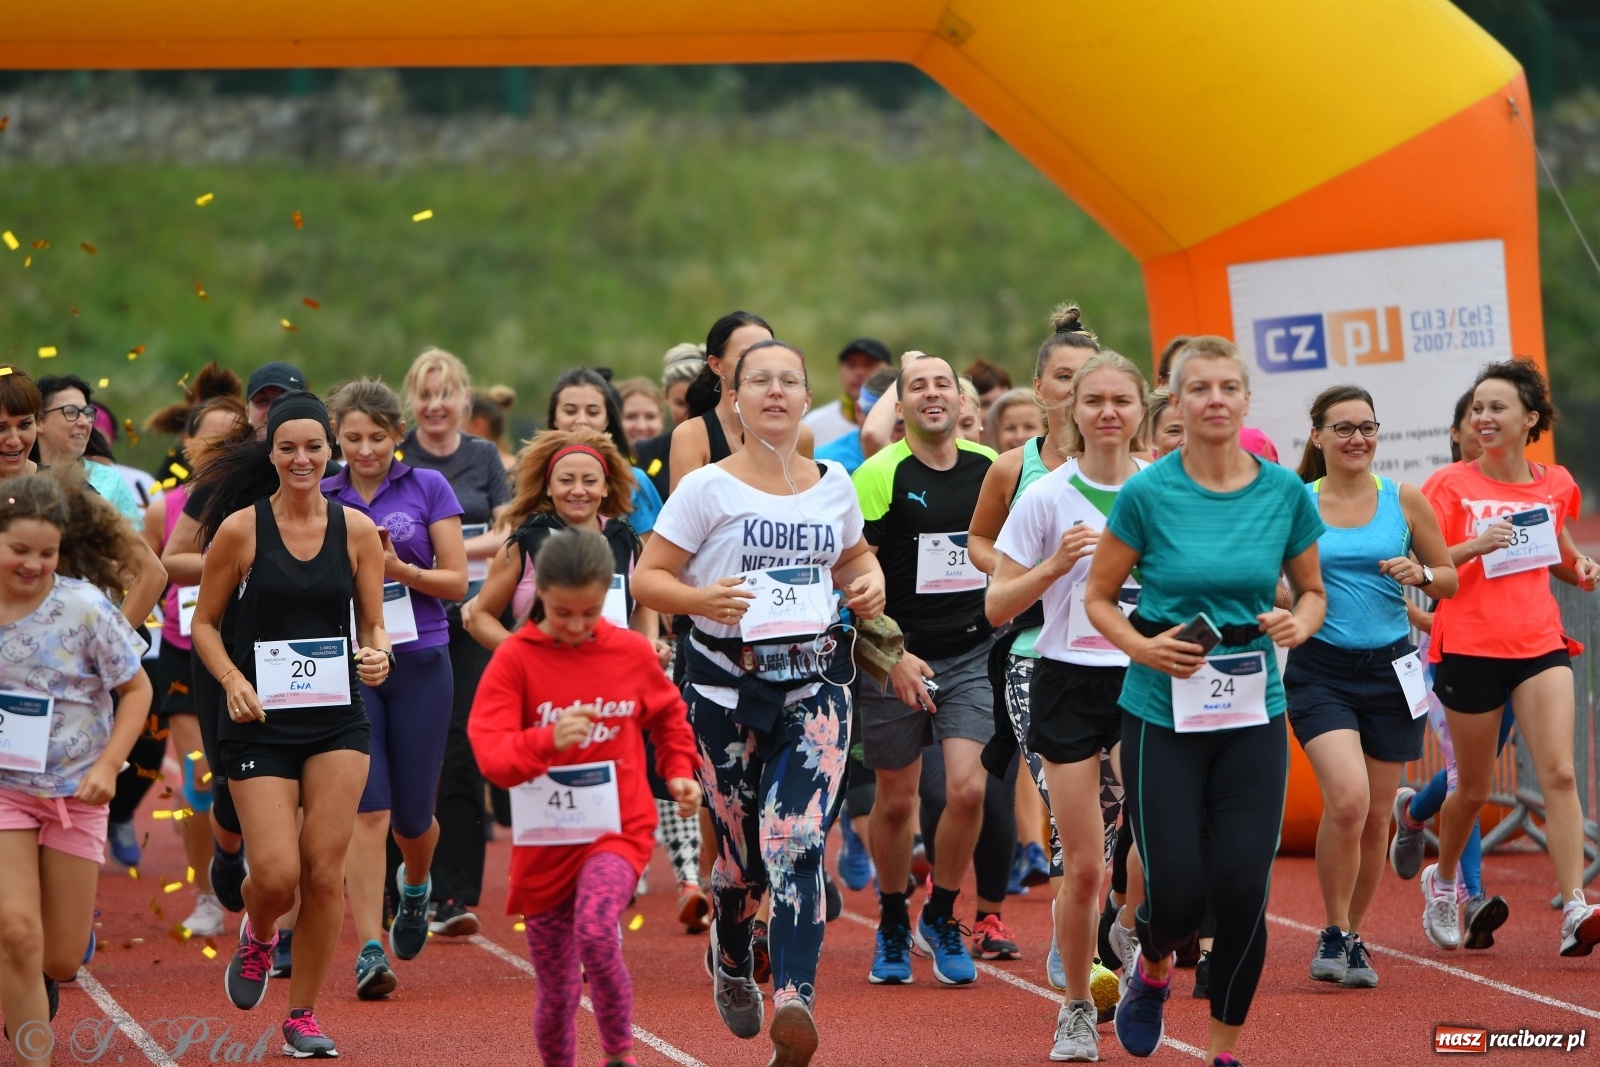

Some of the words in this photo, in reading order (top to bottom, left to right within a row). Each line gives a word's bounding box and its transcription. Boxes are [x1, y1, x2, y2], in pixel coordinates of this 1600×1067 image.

[743, 518, 835, 553] KOBIETA
[947, 549, 966, 566] 31
[772, 586, 797, 606] 34
[766, 652, 784, 663] CASA
[767, 662, 787, 672] PAPEL
[291, 659, 316, 678] 20
[290, 680, 312, 691] EWA
[1210, 677, 1235, 698] 24
[547, 789, 577, 810] 41
